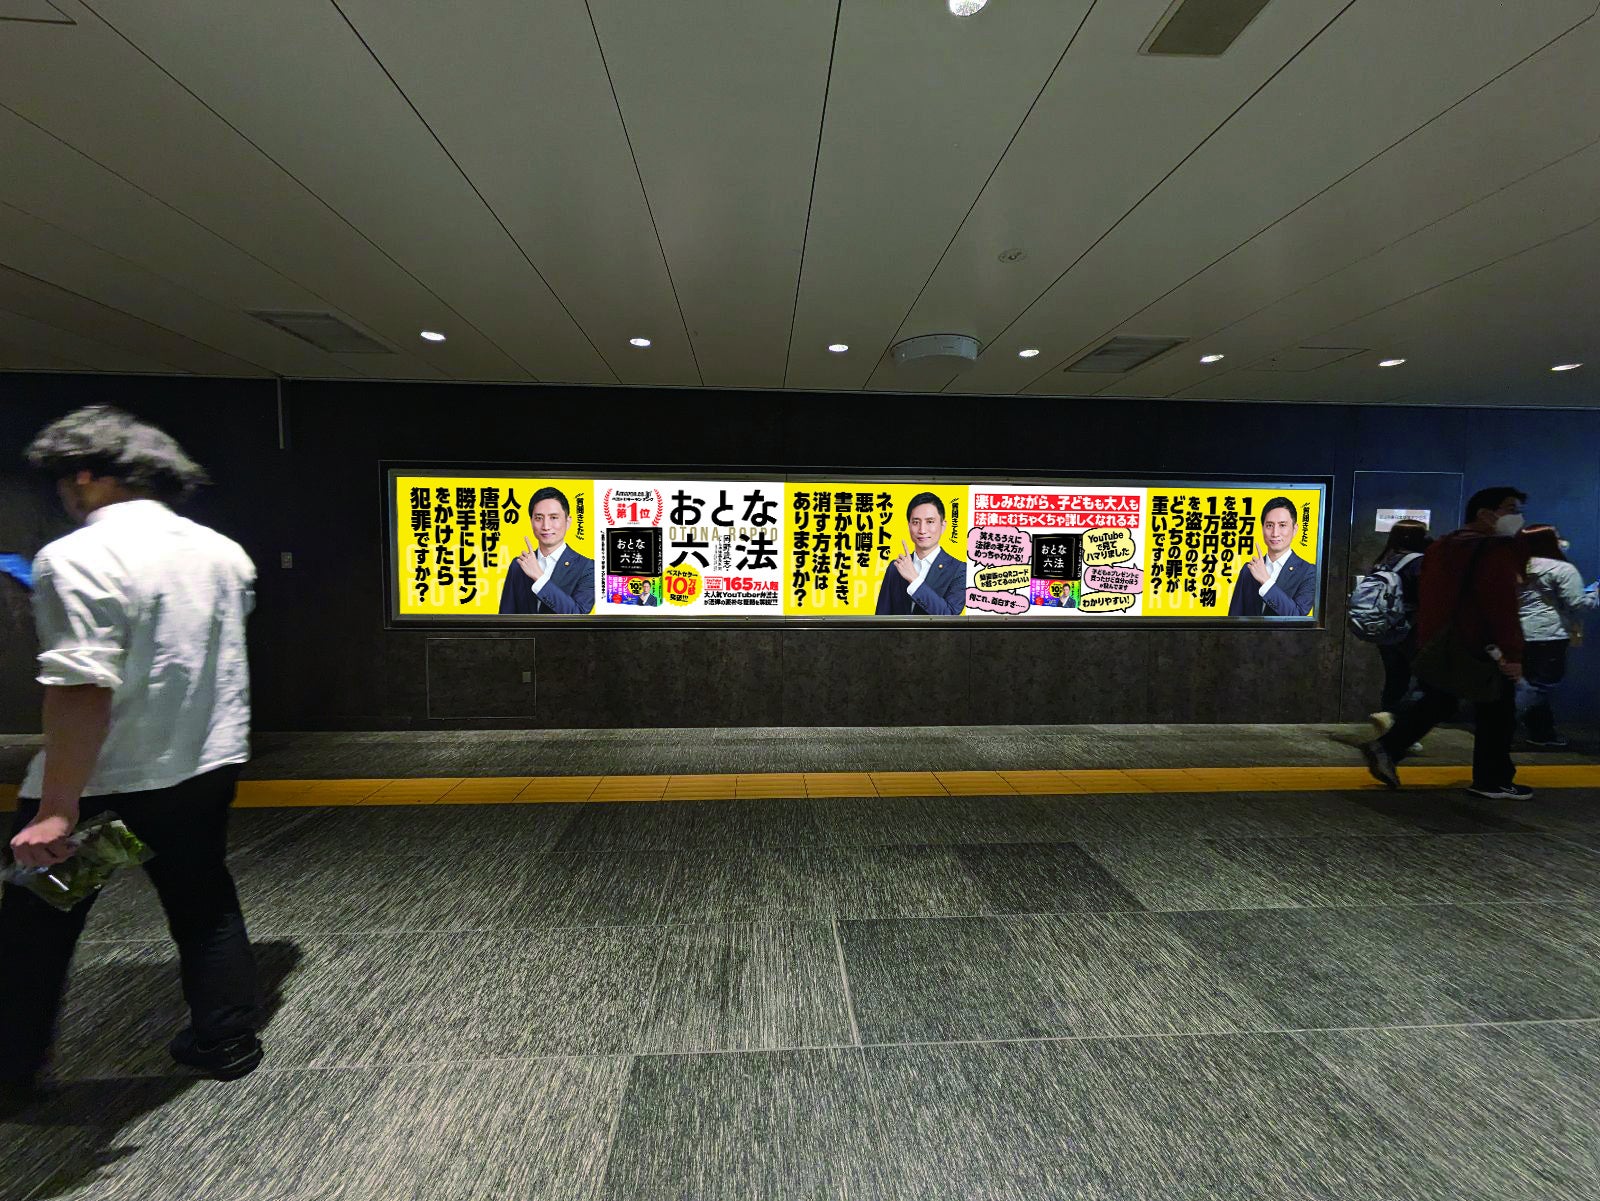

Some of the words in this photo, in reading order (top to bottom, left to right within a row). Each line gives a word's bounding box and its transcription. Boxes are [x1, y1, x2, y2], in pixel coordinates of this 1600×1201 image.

[479, 486, 500, 567] 唐揚げに
[502, 488, 521, 524] 人の
[670, 489, 778, 527] おとな
[855, 492, 873, 567] 悪い噂を
[876, 492, 893, 560] ネットで
[975, 494, 1139, 511] 楽しみながら、子どもも大人も
[975, 512, 1139, 527] 法律にむちゃくちゃ詳しくなれる本
[1238, 497, 1256, 555] 1万円
[410, 487, 431, 602] 犯罪ですか？
[434, 487, 454, 586] をかけたら
[456, 487, 477, 604] 勝手にレモン
[617, 538, 645, 549] おとな
[620, 553, 643, 564] 六法
[669, 531, 778, 571] 六法
[793, 491, 810, 607] ありますか？
[812, 491, 831, 590] 消す方法は
[834, 492, 853, 605] 書かれたとき、
[975, 540, 1024, 553] 法律の考え方が
[1041, 544, 1067, 555] おとな
[1043, 558, 1064, 568] 六法
[1086, 548, 1130, 561] ハマりました
[1088, 531, 1124, 543] YouTube
[1096, 541, 1117, 551] で見て
[1151, 495, 1169, 594] 重いですか？
[1166, 495, 1186, 593] どっちの罪が
[1184, 497, 1203, 598] を盗むのでは、
[1200, 497, 1220, 607] 1万円分の物
[1221, 496, 1238, 583] を盗むのと、
[1083, 596, 1130, 607] わかりやすい！
